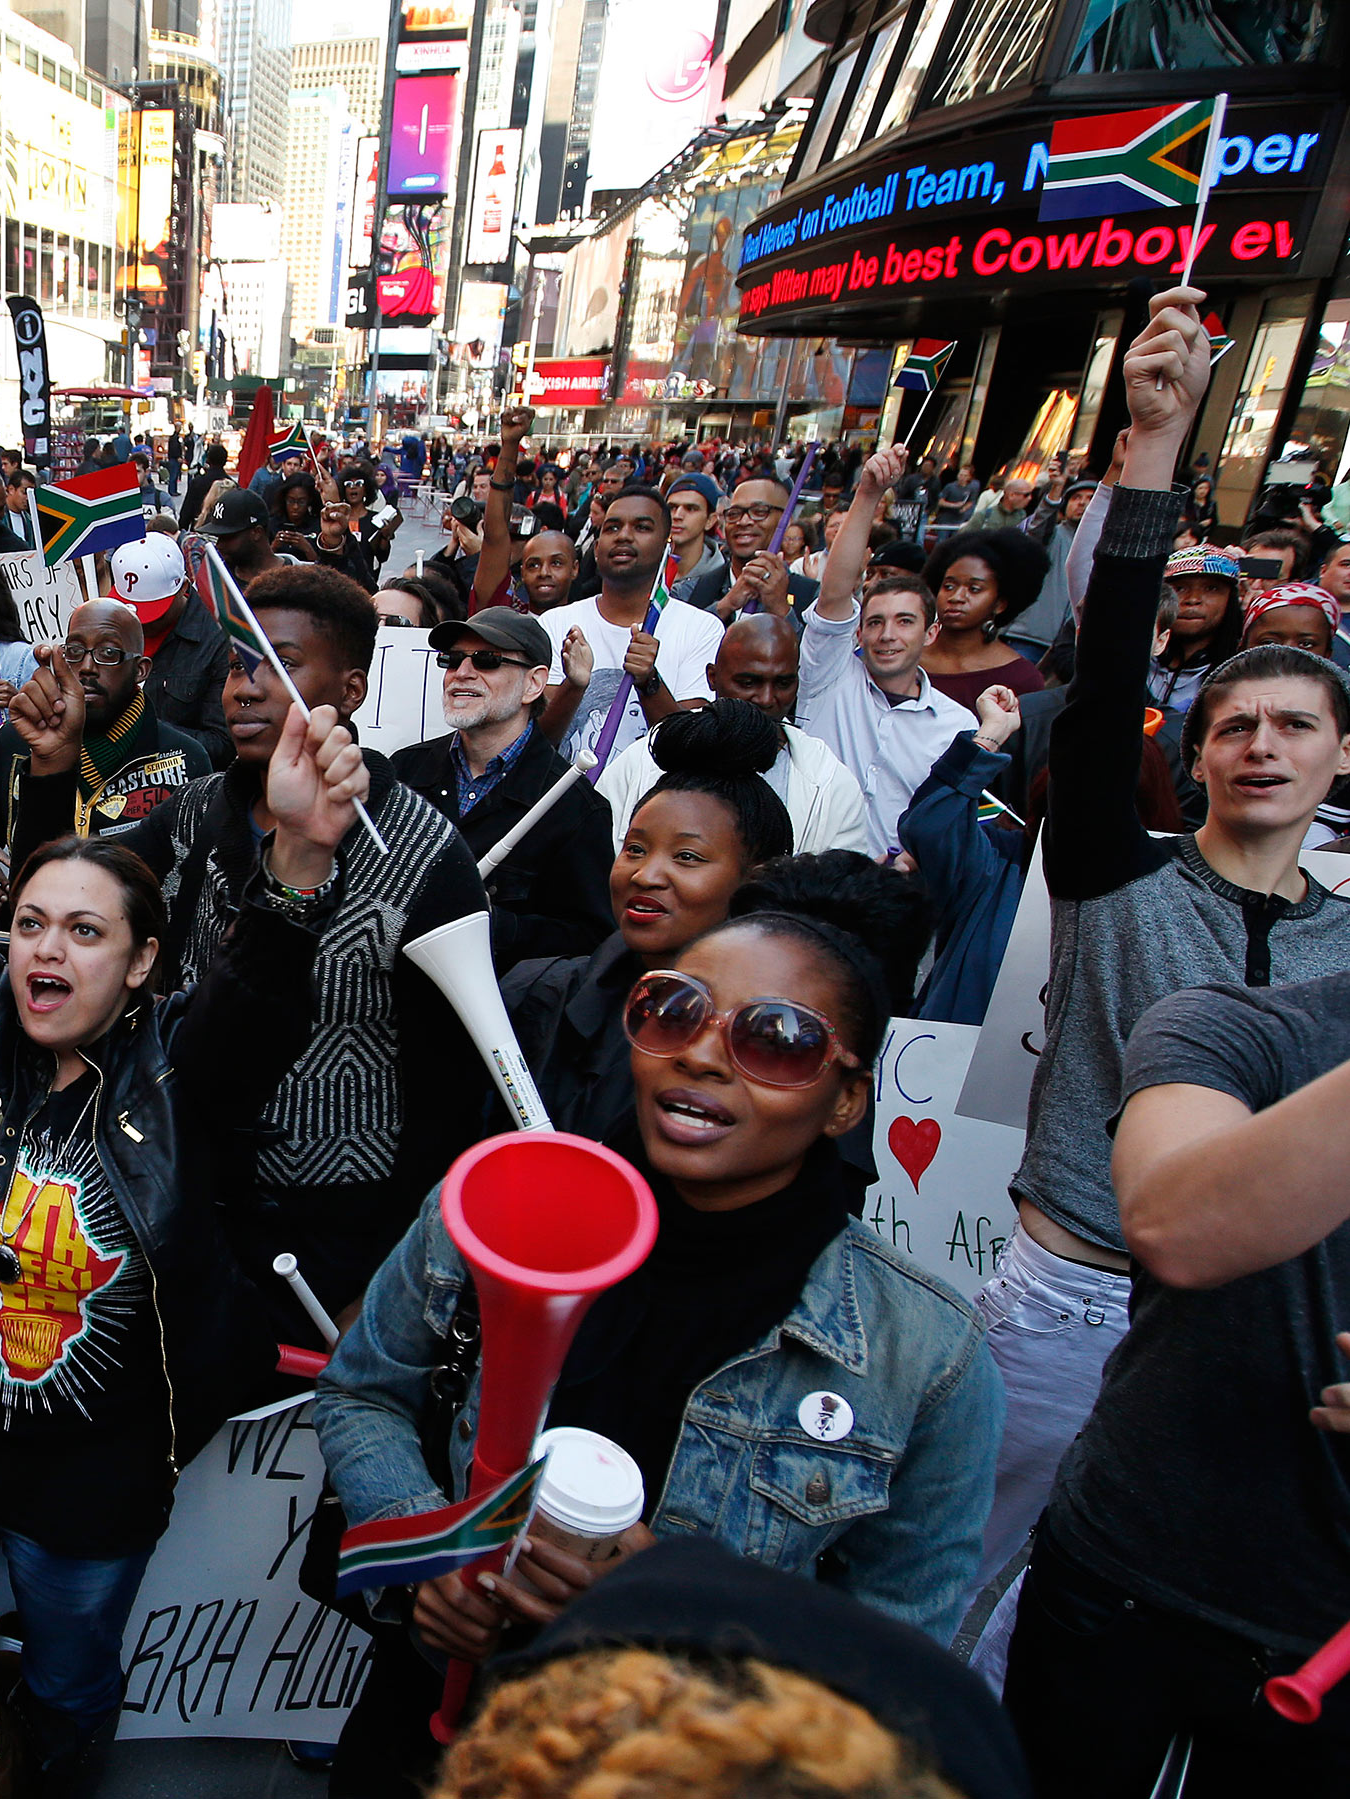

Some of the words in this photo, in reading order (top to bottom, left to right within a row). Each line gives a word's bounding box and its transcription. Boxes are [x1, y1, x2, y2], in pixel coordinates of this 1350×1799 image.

[801, 209, 821, 241] on
[820, 171, 899, 235] Football
[904, 161, 1005, 212] Team,
[1210, 130, 1321, 187] per
[771, 268, 809, 306] Witten
[810, 261, 849, 302] may
[848, 250, 879, 291] be
[881, 235, 963, 286] best
[972, 218, 1217, 276] Cowboy
[539, 376, 571, 391] RKISH
[1, 559, 34, 591] ARS
[123, 572, 139, 593] P
[23, 593, 64, 643] ACY
[126, 805, 142, 816] PIER
[875, 1030, 937, 1105] YC
[870, 1194, 913, 1254] th
[945, 1209, 1008, 1276] Afr
[227, 1401, 316, 1480] WE
[266, 1496, 315, 1581] Y
[122, 1598, 259, 1723] BRA
